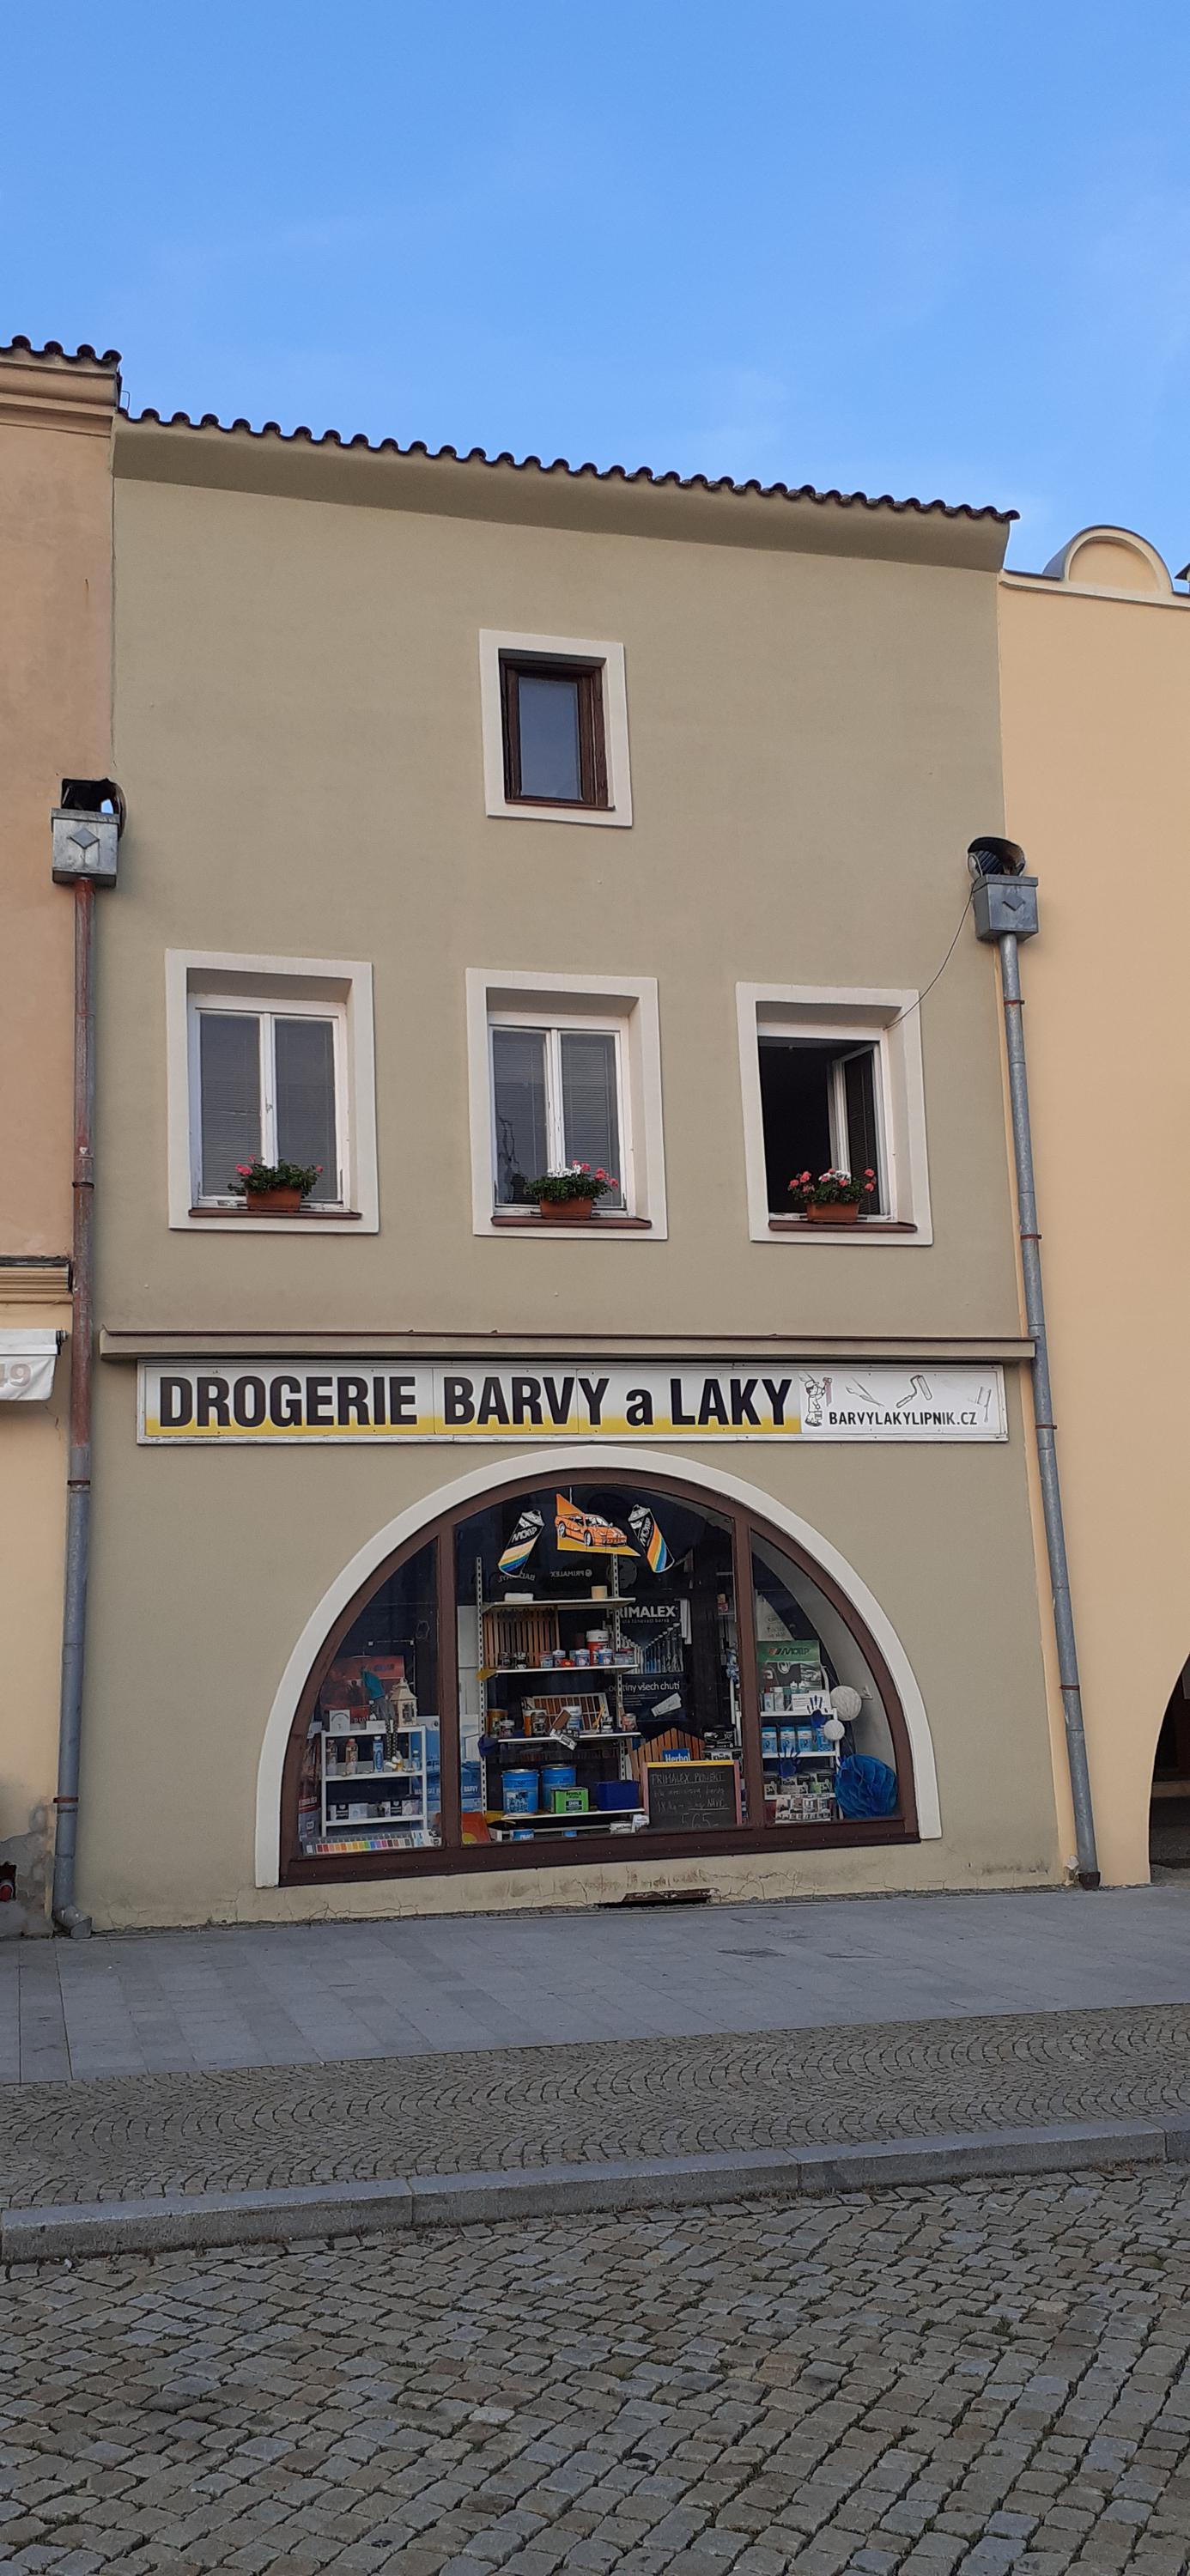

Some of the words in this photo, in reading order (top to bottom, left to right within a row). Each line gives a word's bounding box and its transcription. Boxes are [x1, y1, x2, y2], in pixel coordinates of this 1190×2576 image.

[160, 1376, 417, 1427] DROGERIE
[443, 1376, 609, 1426] BARVY
[626, 1388, 654, 1426] a
[671, 1378, 792, 1426] LAKY
[829, 1411, 978, 1425] BARVYLAKYLIPNIK.CZ
[638, 1681, 659, 1691] všech
[660, 1680, 680, 1690] chutí
